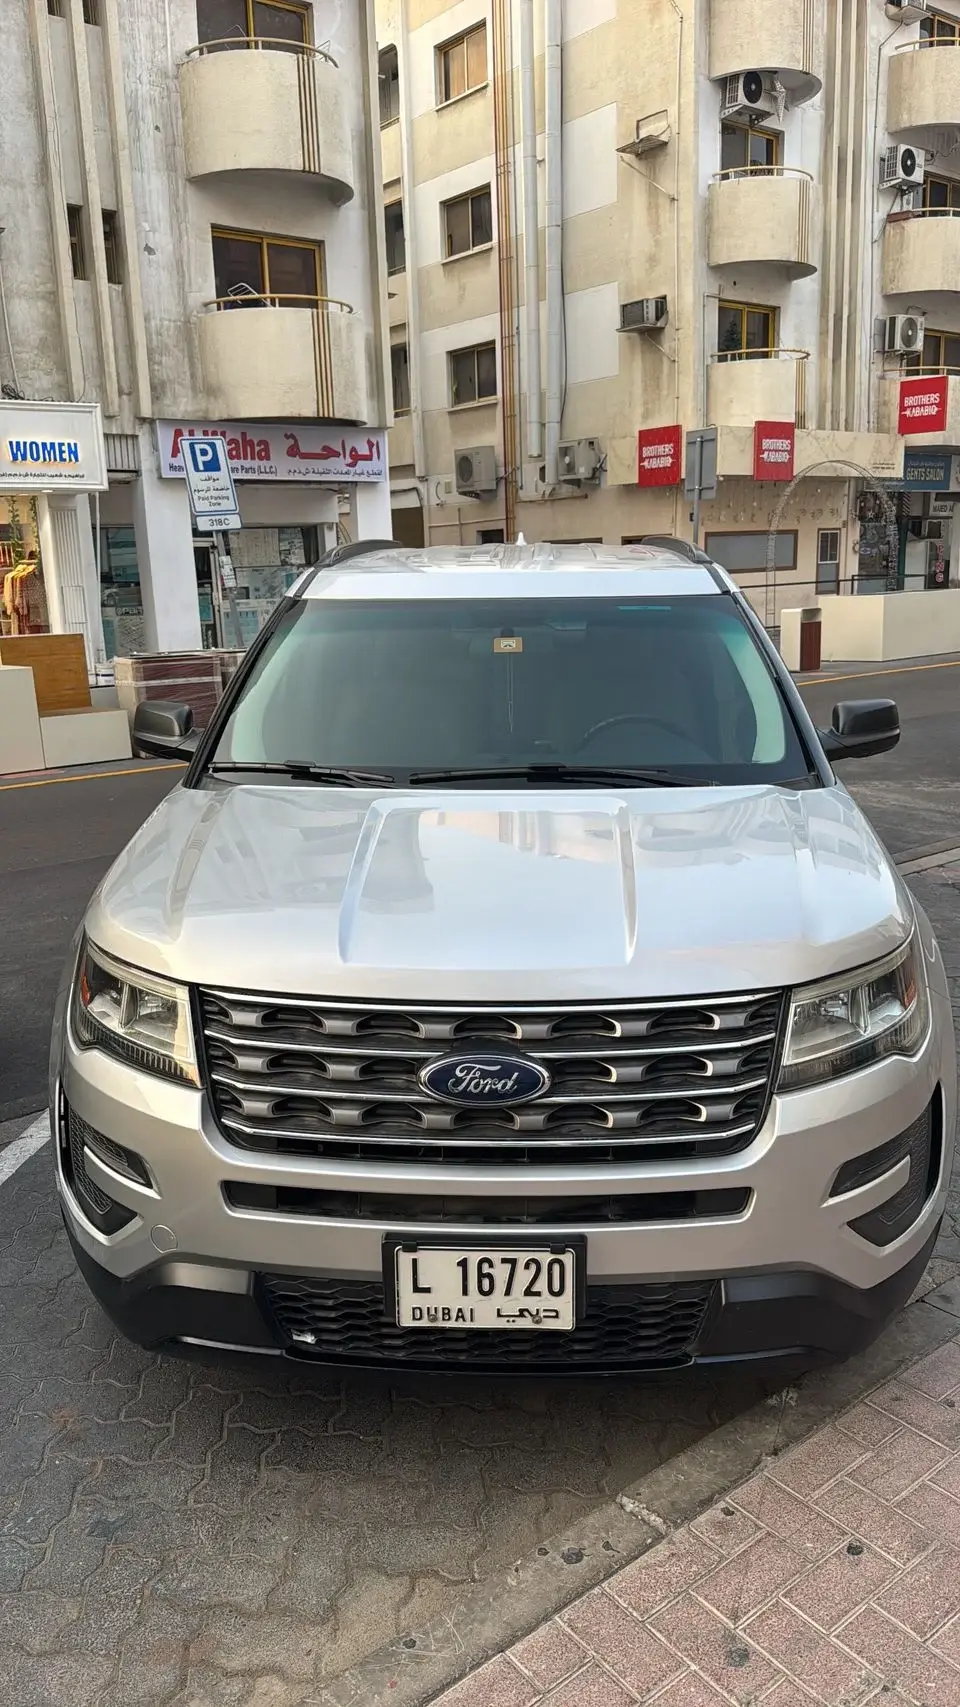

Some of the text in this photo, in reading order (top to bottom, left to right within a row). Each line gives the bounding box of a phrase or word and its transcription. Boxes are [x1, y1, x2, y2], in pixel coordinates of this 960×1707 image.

[904, 393, 940, 407] BROTHERS
[8, 440, 80, 463] WOMEN
[284, 433, 380, 468] الواحة
[642, 444, 674, 457] BROTHERS
[762, 439, 791, 451] BROTHERS
[241, 465, 256, 475] Parts
[907, 468, 944, 480] GENTS SALON
[200, 474, 219, 483] مواقف
[208, 517, 230, 527] 318C
[448, 1063, 519, 1094] Ford
[411, 1257, 565, 1297] L 16720
[411, 1306, 475, 1323] DUBAI
[497, 1308, 559, 1323] دبي
